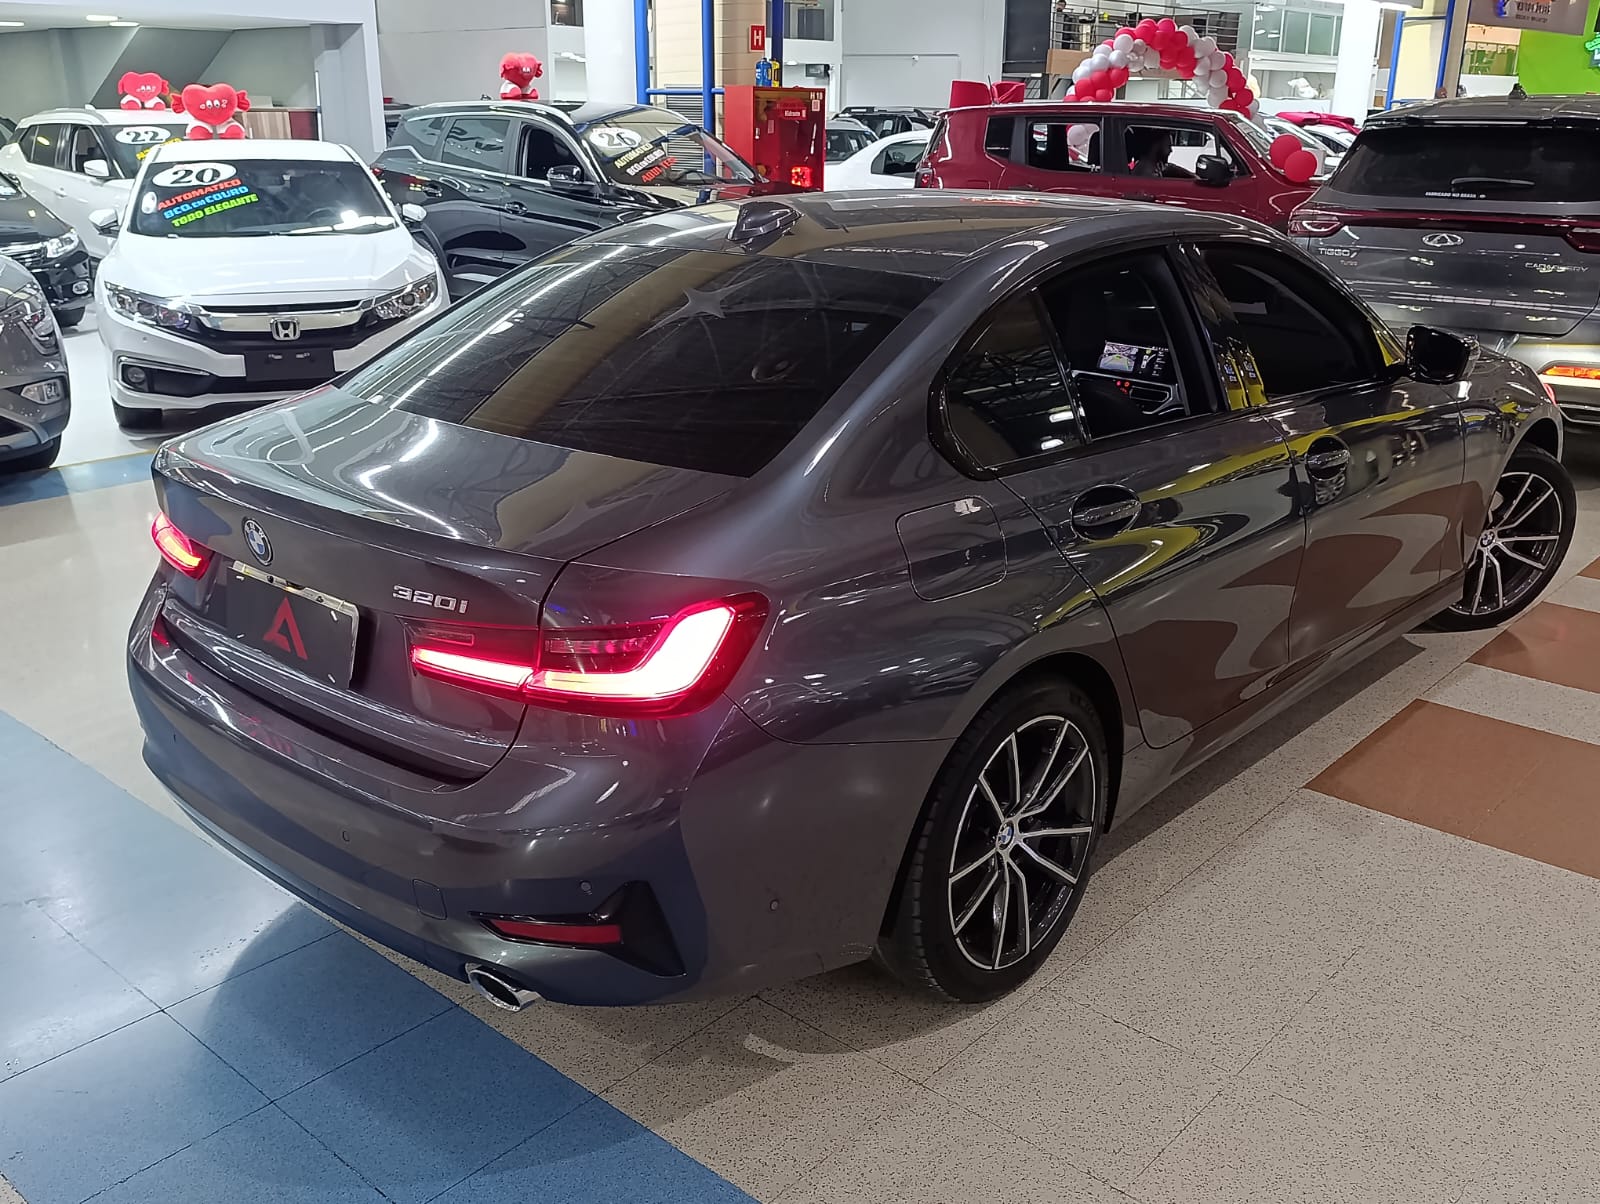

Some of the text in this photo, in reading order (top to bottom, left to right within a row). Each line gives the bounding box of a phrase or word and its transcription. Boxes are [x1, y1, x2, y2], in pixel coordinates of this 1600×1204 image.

[754, 30, 762, 46] H
[126, 130, 163, 142] 22
[598, 132, 637, 147] 26
[170, 168, 221, 184] 20
[205, 185, 249, 203] COURO
[172, 194, 259, 227] TODO ELEGANTE
